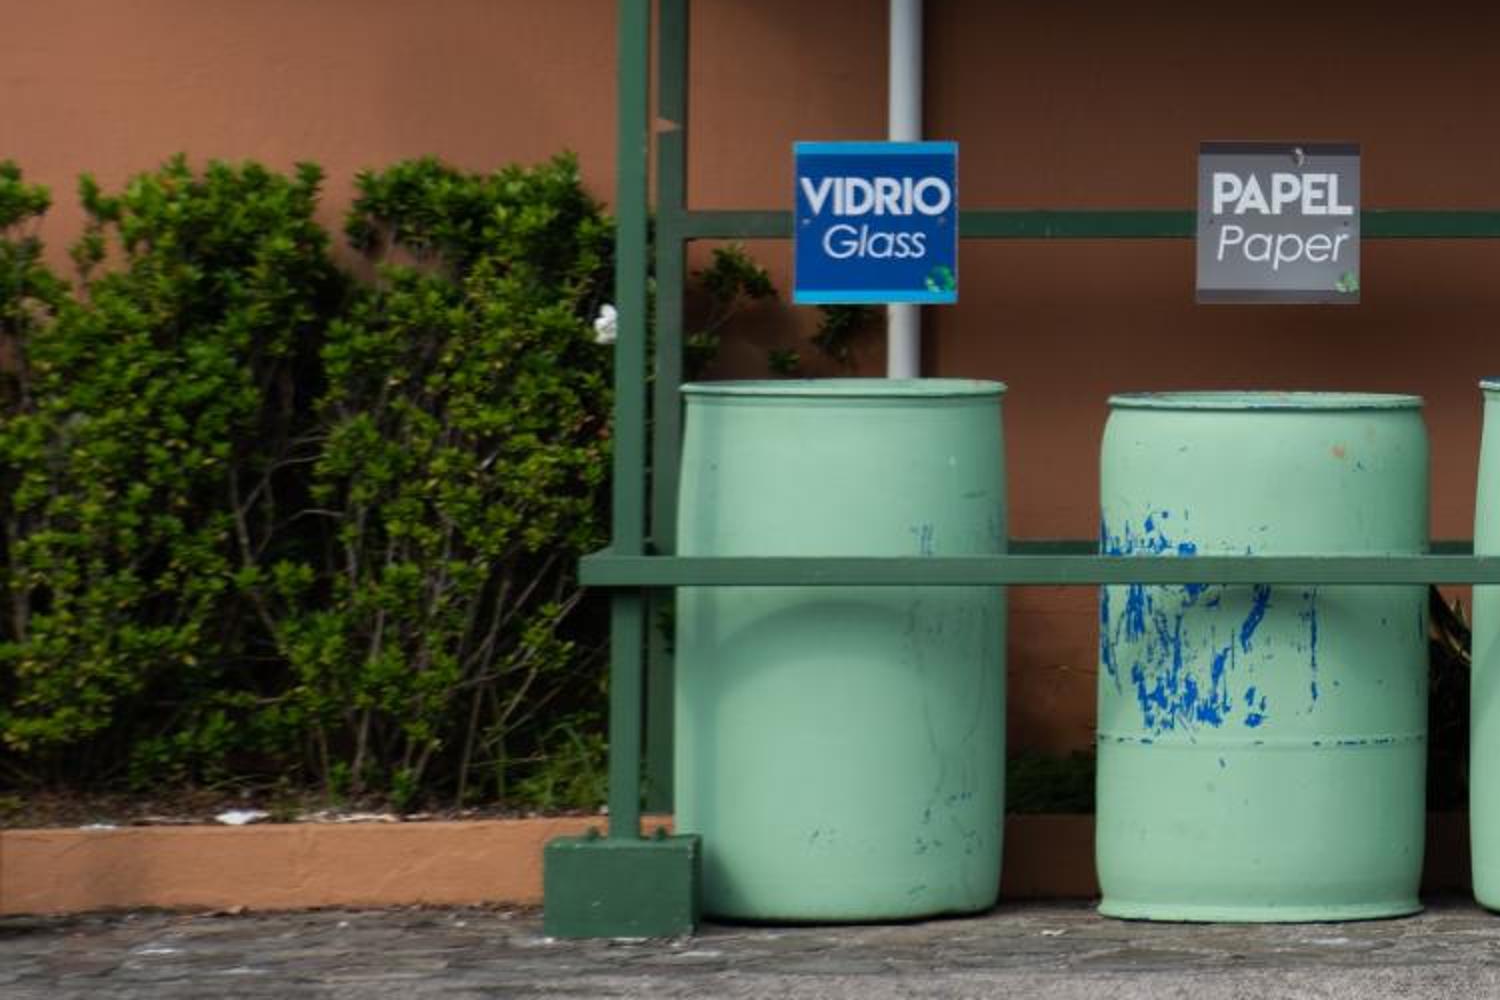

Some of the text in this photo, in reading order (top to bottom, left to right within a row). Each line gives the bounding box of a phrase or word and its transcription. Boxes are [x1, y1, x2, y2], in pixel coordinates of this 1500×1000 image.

[800, 177, 951, 216] VIDRIO
[1212, 172, 1354, 216] PAPEL
[823, 224, 926, 259] Glass
[1217, 225, 1349, 271] Paper
